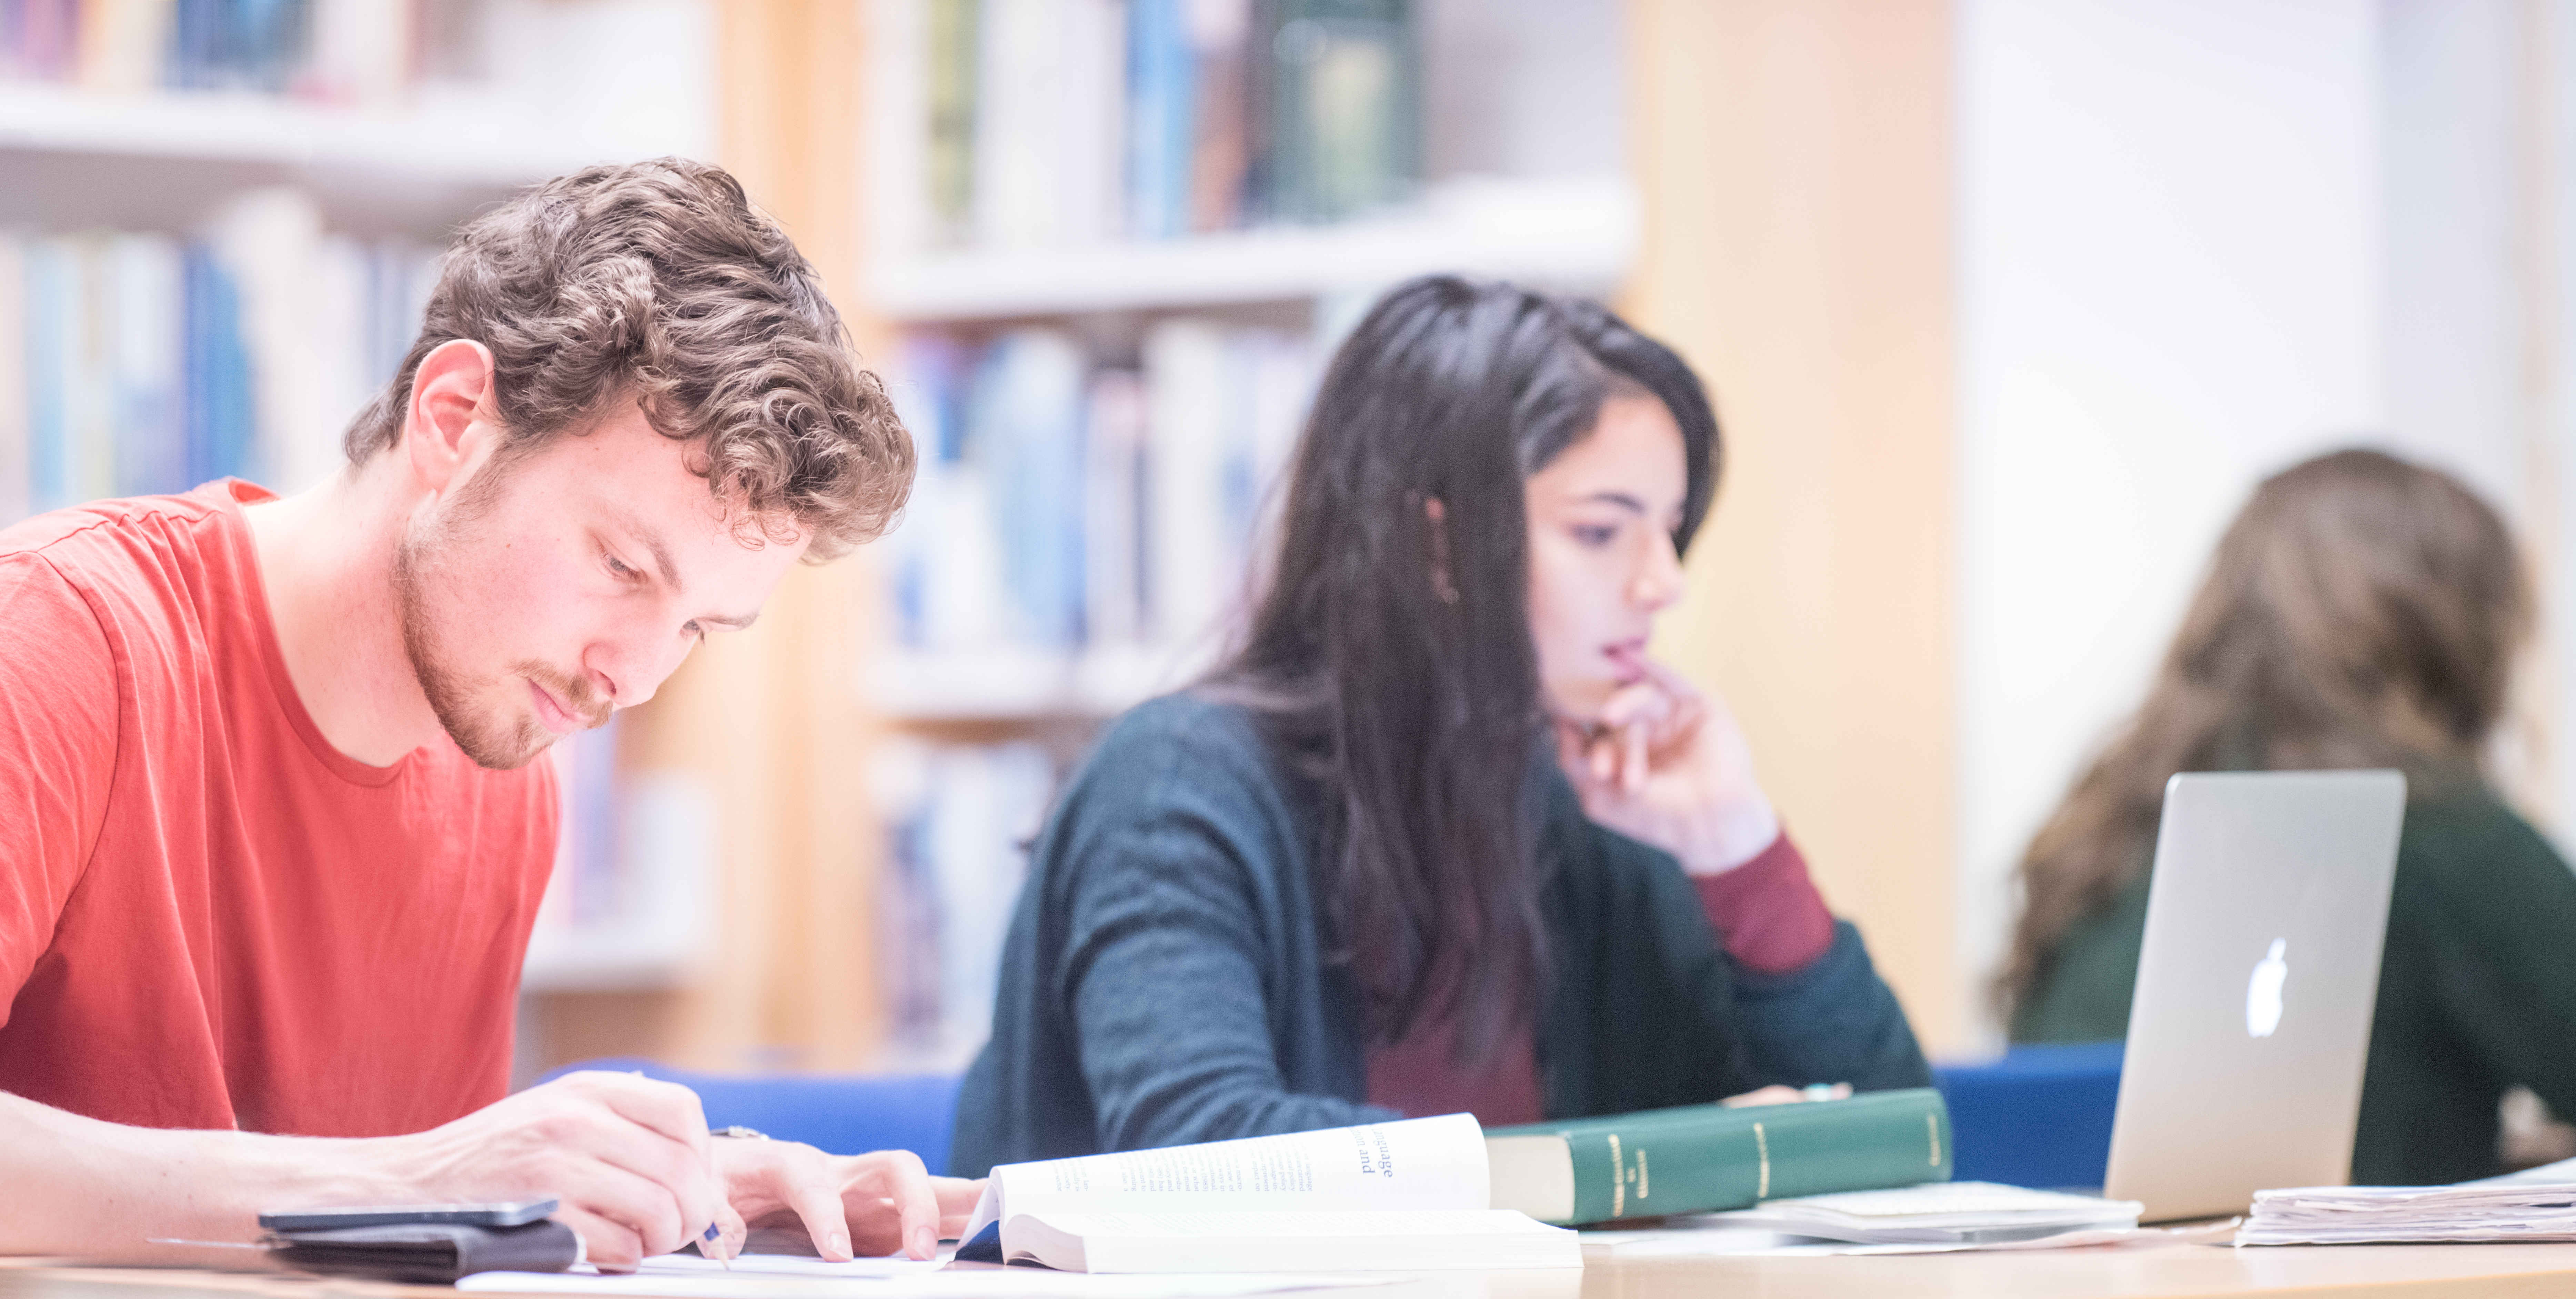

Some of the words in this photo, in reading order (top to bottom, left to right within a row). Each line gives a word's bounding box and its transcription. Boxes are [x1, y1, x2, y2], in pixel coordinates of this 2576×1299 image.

[1359, 1150, 1375, 1174] and
[1255, 1183, 1260, 1191] on
[1279, 1172, 1287, 1191] policy
